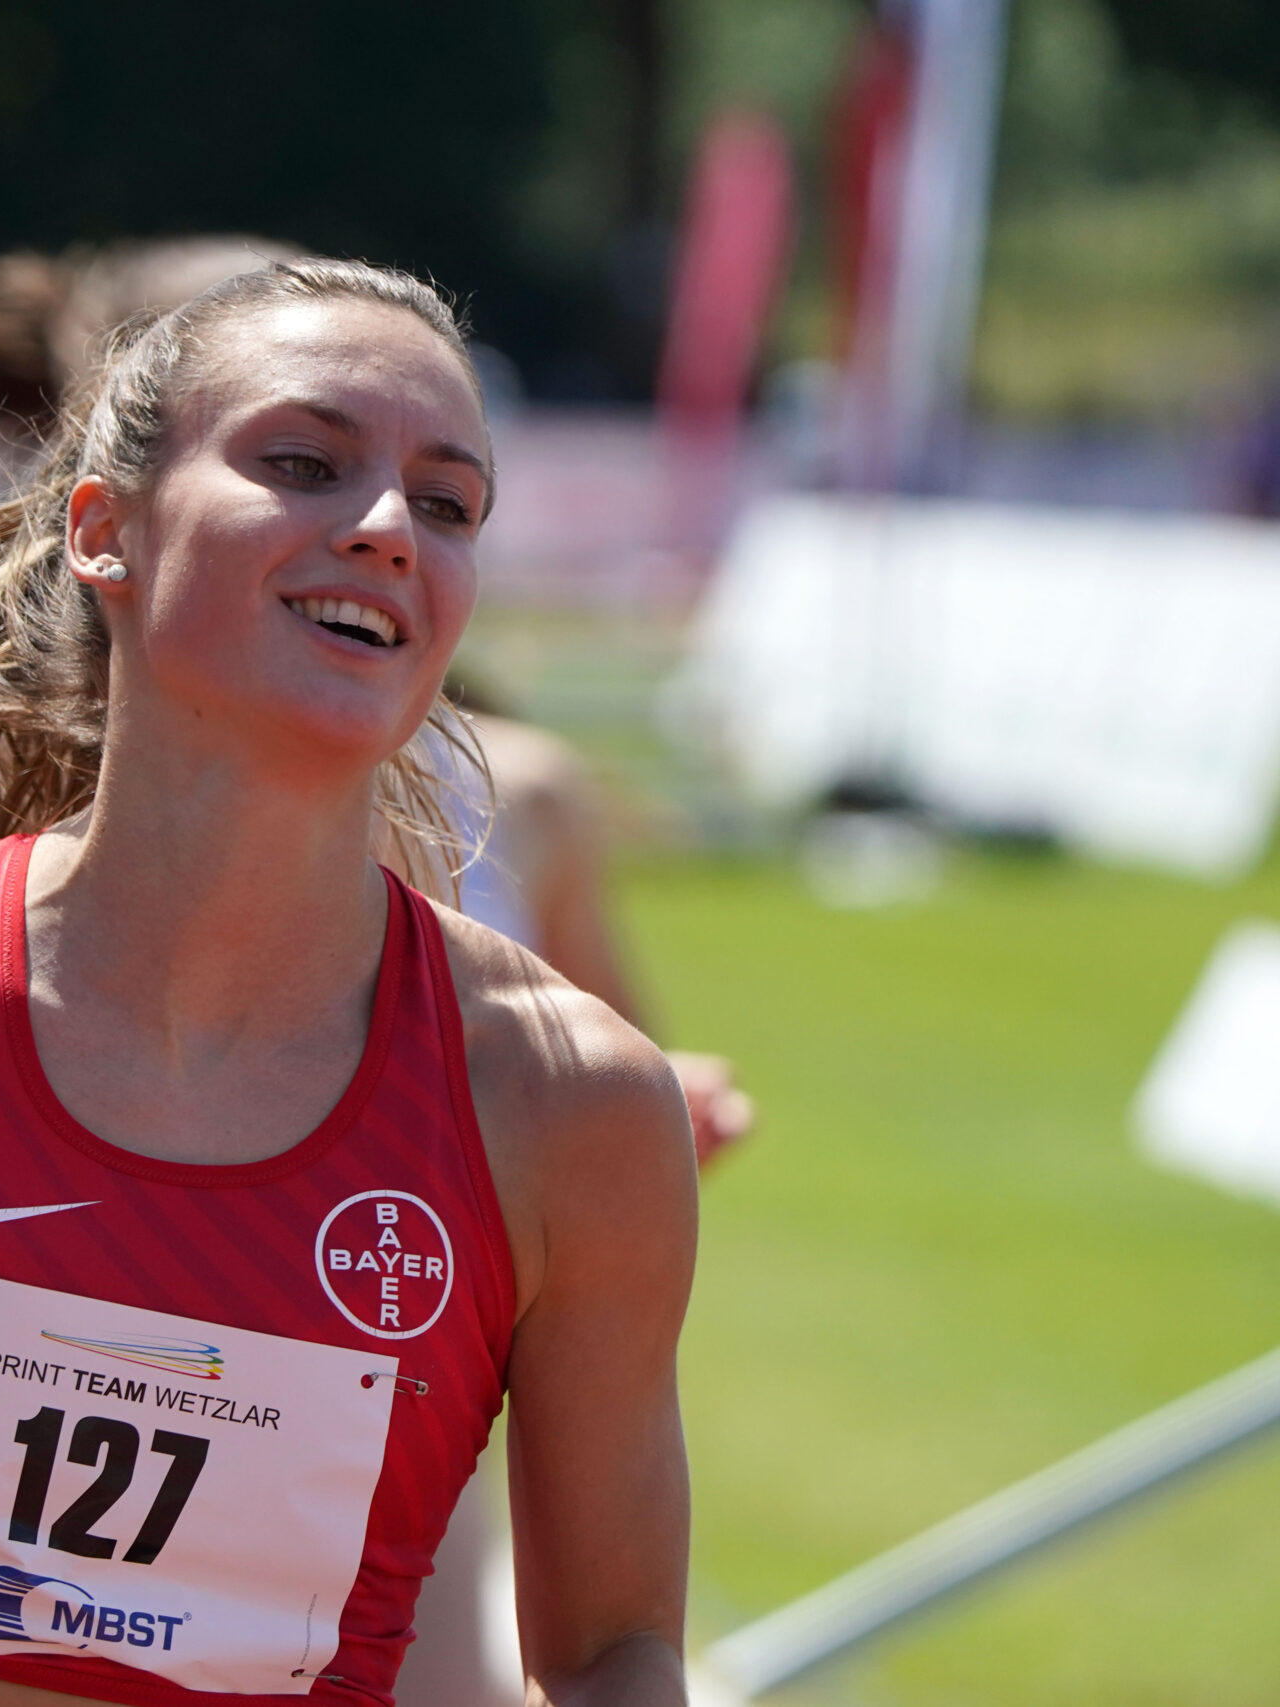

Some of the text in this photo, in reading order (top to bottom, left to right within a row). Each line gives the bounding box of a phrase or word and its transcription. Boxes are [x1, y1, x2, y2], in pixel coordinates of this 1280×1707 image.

[329, 1248, 445, 1281] BAYER
[375, 1202, 402, 1328] BAYER
[73, 1368, 147, 1403] TEAM
[155, 1385, 281, 1430] WETZLAR
[8, 1406, 210, 1566] 127
